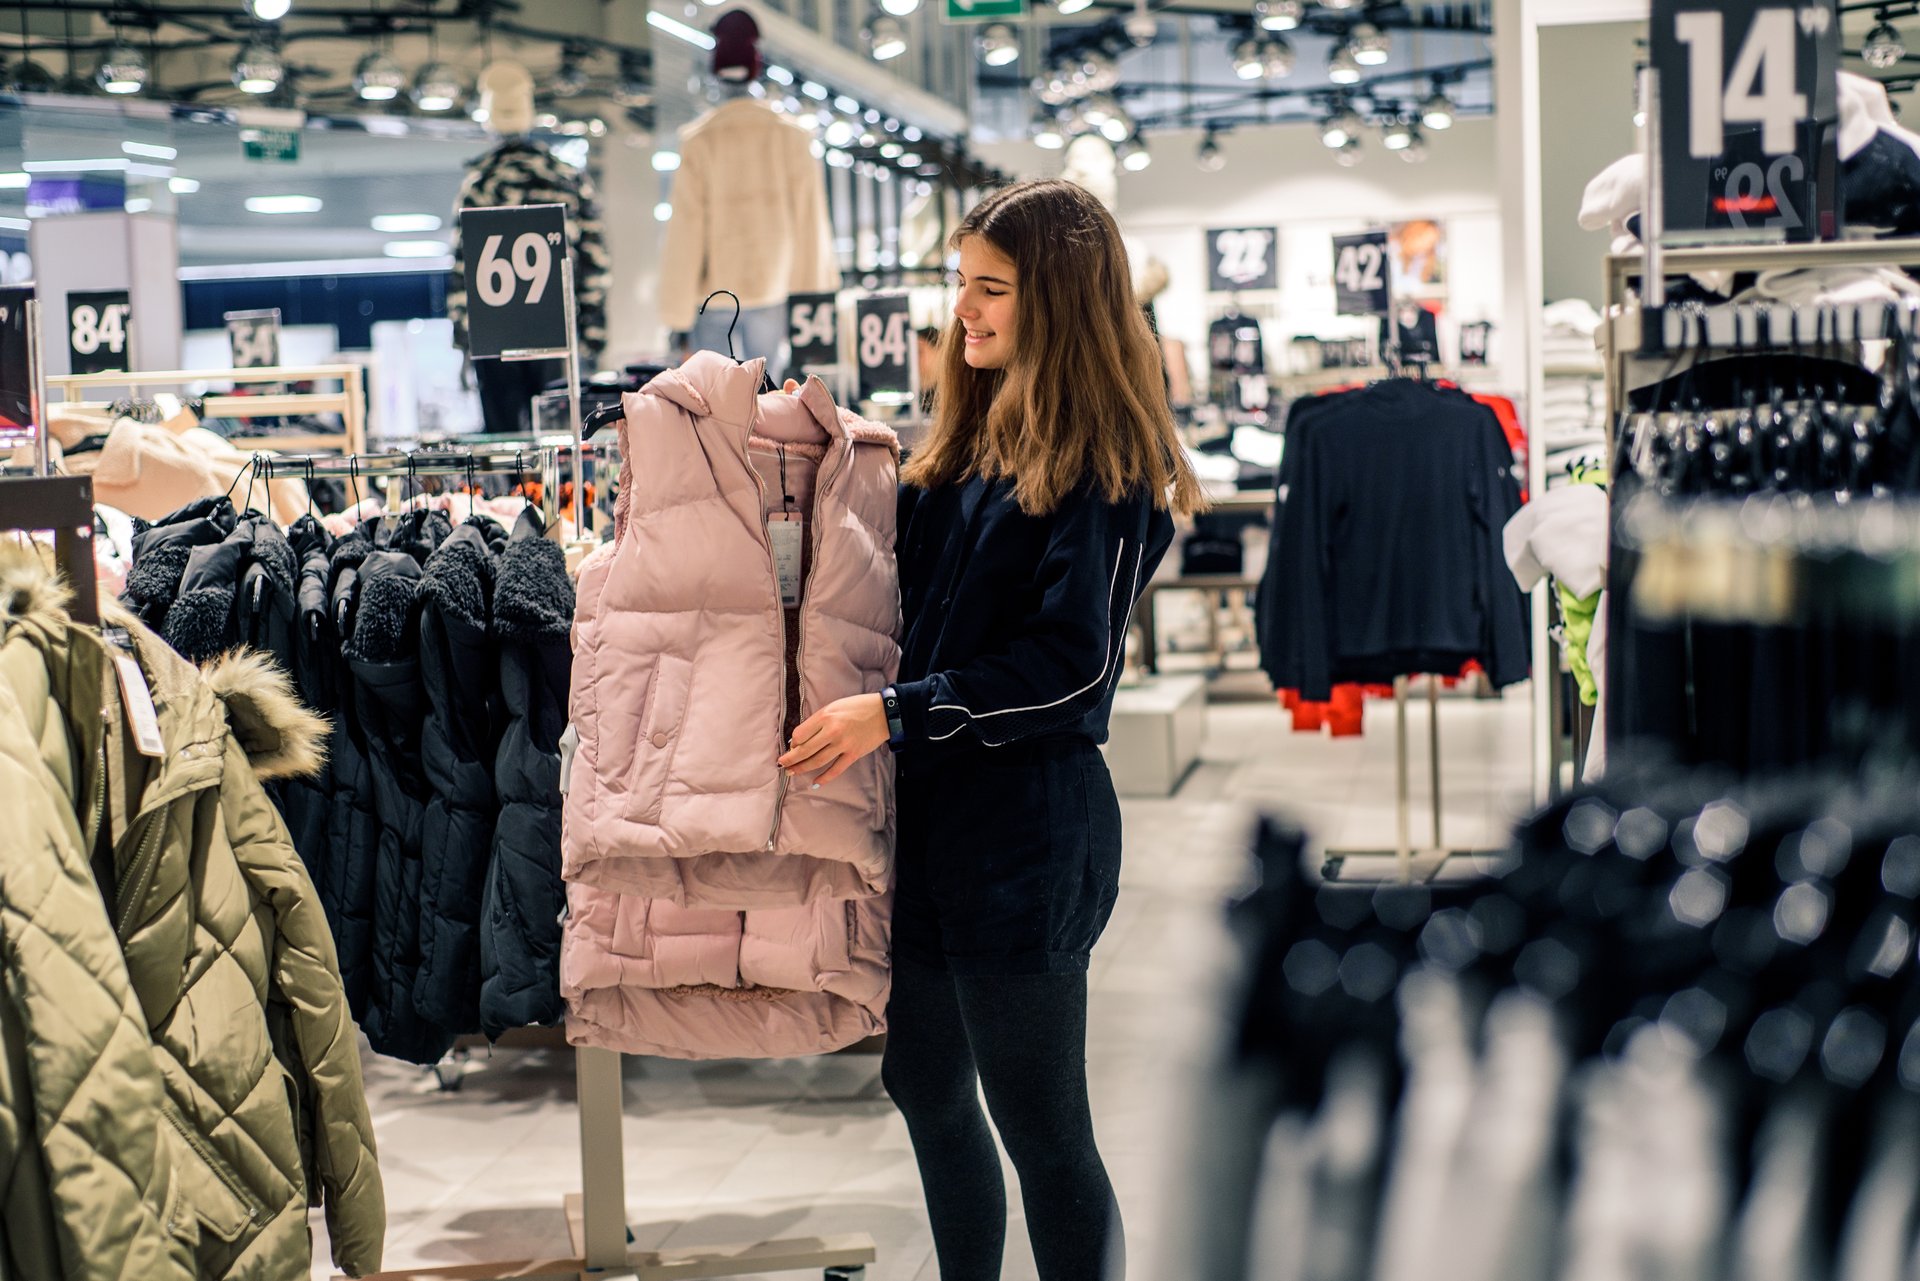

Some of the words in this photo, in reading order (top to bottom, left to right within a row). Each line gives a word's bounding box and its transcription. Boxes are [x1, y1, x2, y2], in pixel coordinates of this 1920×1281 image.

[1675, 8, 1807, 158] 14
[476, 232, 552, 307] 69
[1336, 243, 1383, 292] 42
[71, 304, 126, 355] 84
[791, 302, 834, 347] 54
[860, 312, 907, 368] 84
